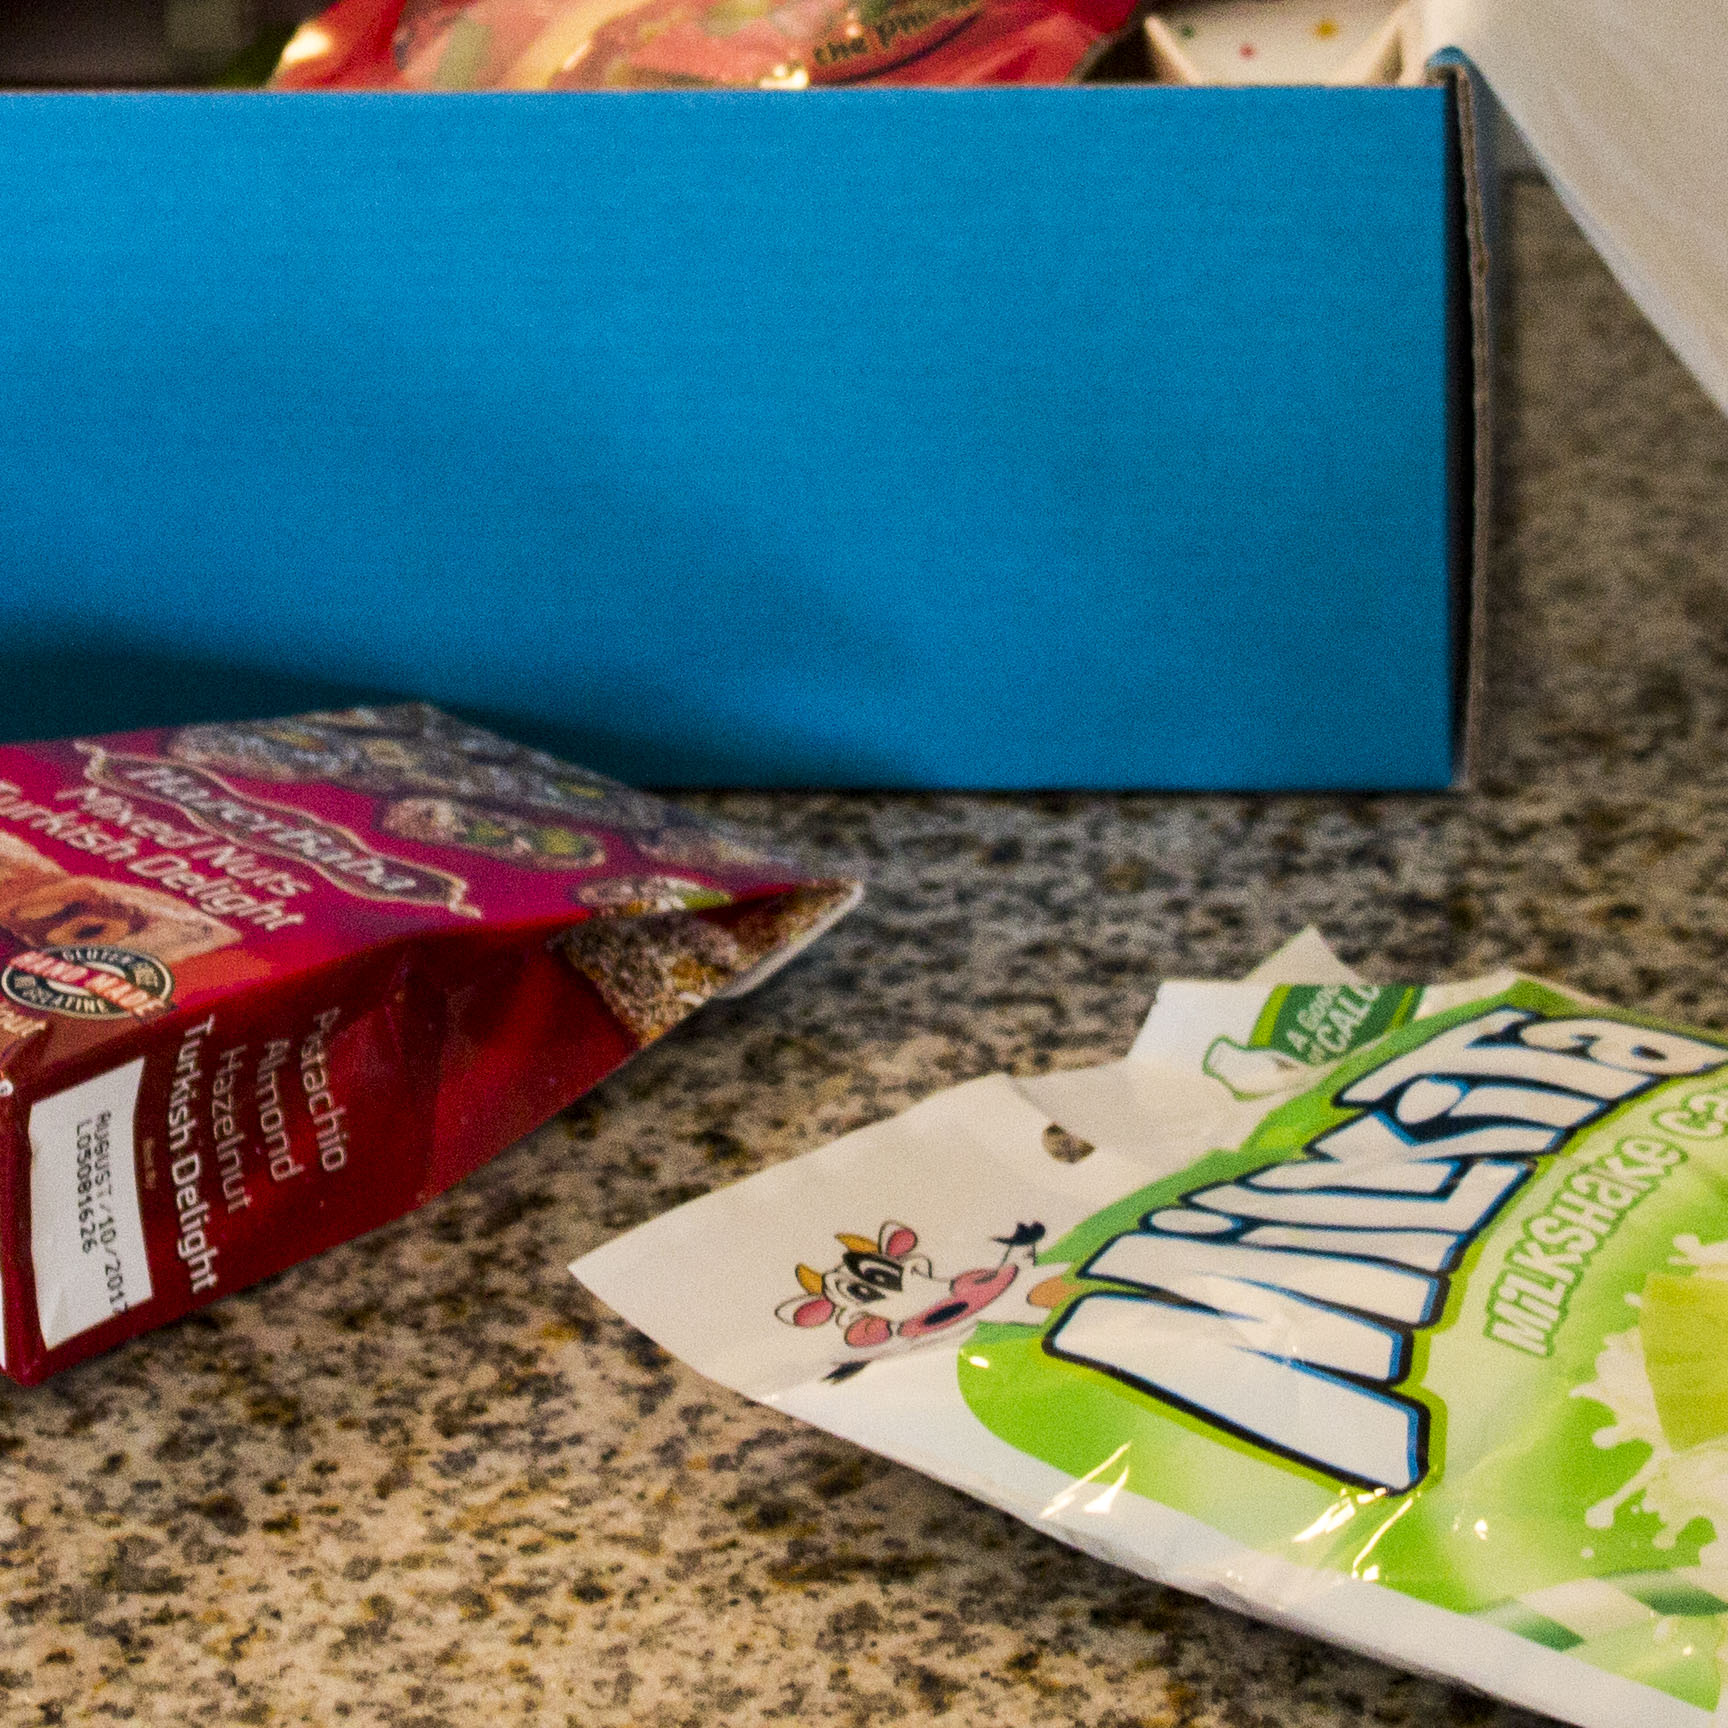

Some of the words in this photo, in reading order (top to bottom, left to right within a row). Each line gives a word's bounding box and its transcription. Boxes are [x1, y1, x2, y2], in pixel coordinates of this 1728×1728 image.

[55, 784, 213, 850] Mixed
[190, 841, 313, 899] Nuts
[127, 854, 306, 932] Delight
[168, 1012, 216, 1155] Turkish
[210, 1043, 254, 1215] Hazelnut
[255, 1036, 308, 1184] Almond
[299, 1005, 352, 1174] Pistachio
[170, 1150, 221, 1296] Delight
